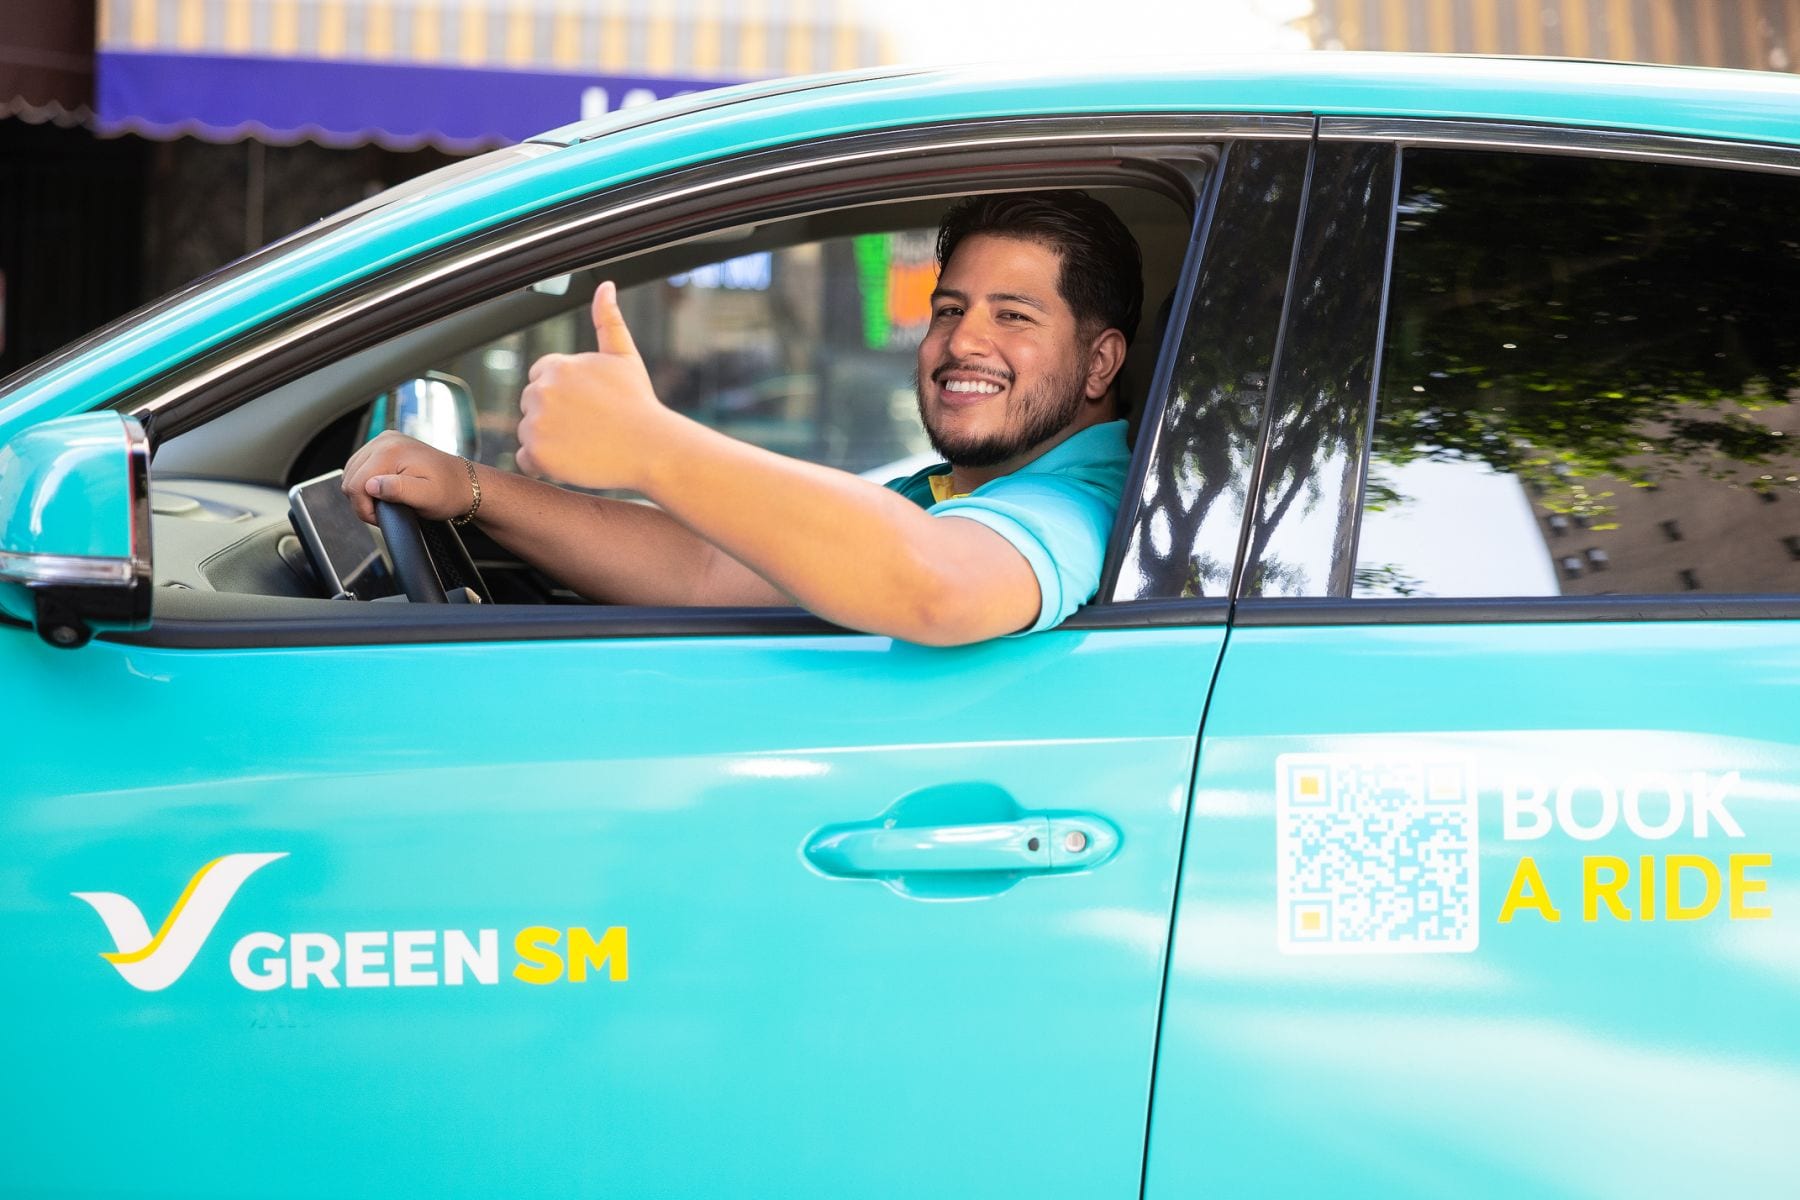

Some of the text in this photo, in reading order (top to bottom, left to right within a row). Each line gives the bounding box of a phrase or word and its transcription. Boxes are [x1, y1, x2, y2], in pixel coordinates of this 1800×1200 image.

[1503, 772, 1746, 840] BOOK
[1499, 854, 1773, 923] A RIDE
[229, 926, 629, 991] GREEN SM
